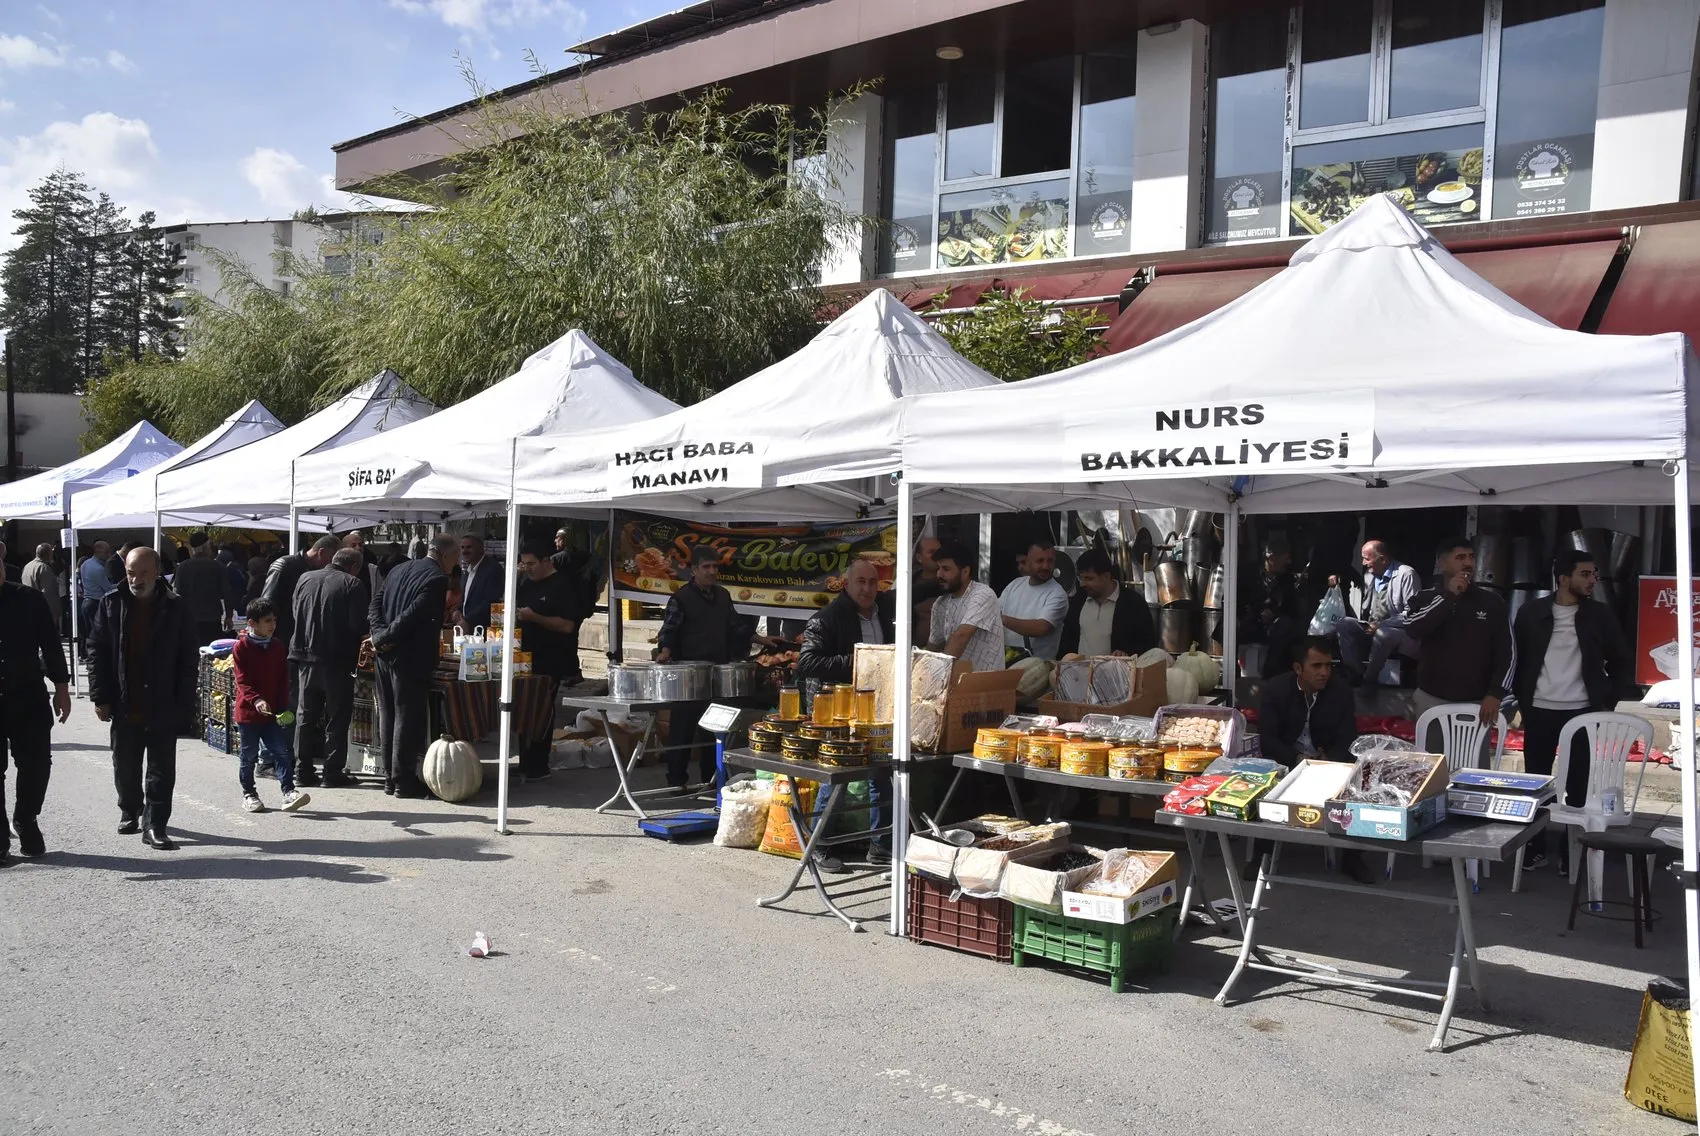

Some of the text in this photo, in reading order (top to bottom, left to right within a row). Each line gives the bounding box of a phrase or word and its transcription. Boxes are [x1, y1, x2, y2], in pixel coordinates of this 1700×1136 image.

[1516, 144, 1543, 170] DOSTLAR
[1155, 403, 1265, 431] NURS
[615, 441, 754, 466] HACI BABA
[1081, 432, 1349, 471] BAKKALİYESİ
[348, 466, 372, 491] ŞİFA
[632, 467, 728, 489] MANAVI
[736, 538, 852, 575] Balevi
[737, 574, 785, 585] Karakovan
[786, 577, 805, 586] Balı
[364, 764, 380, 773] 0507
[1645, 1086, 1668, 1103] 3310
